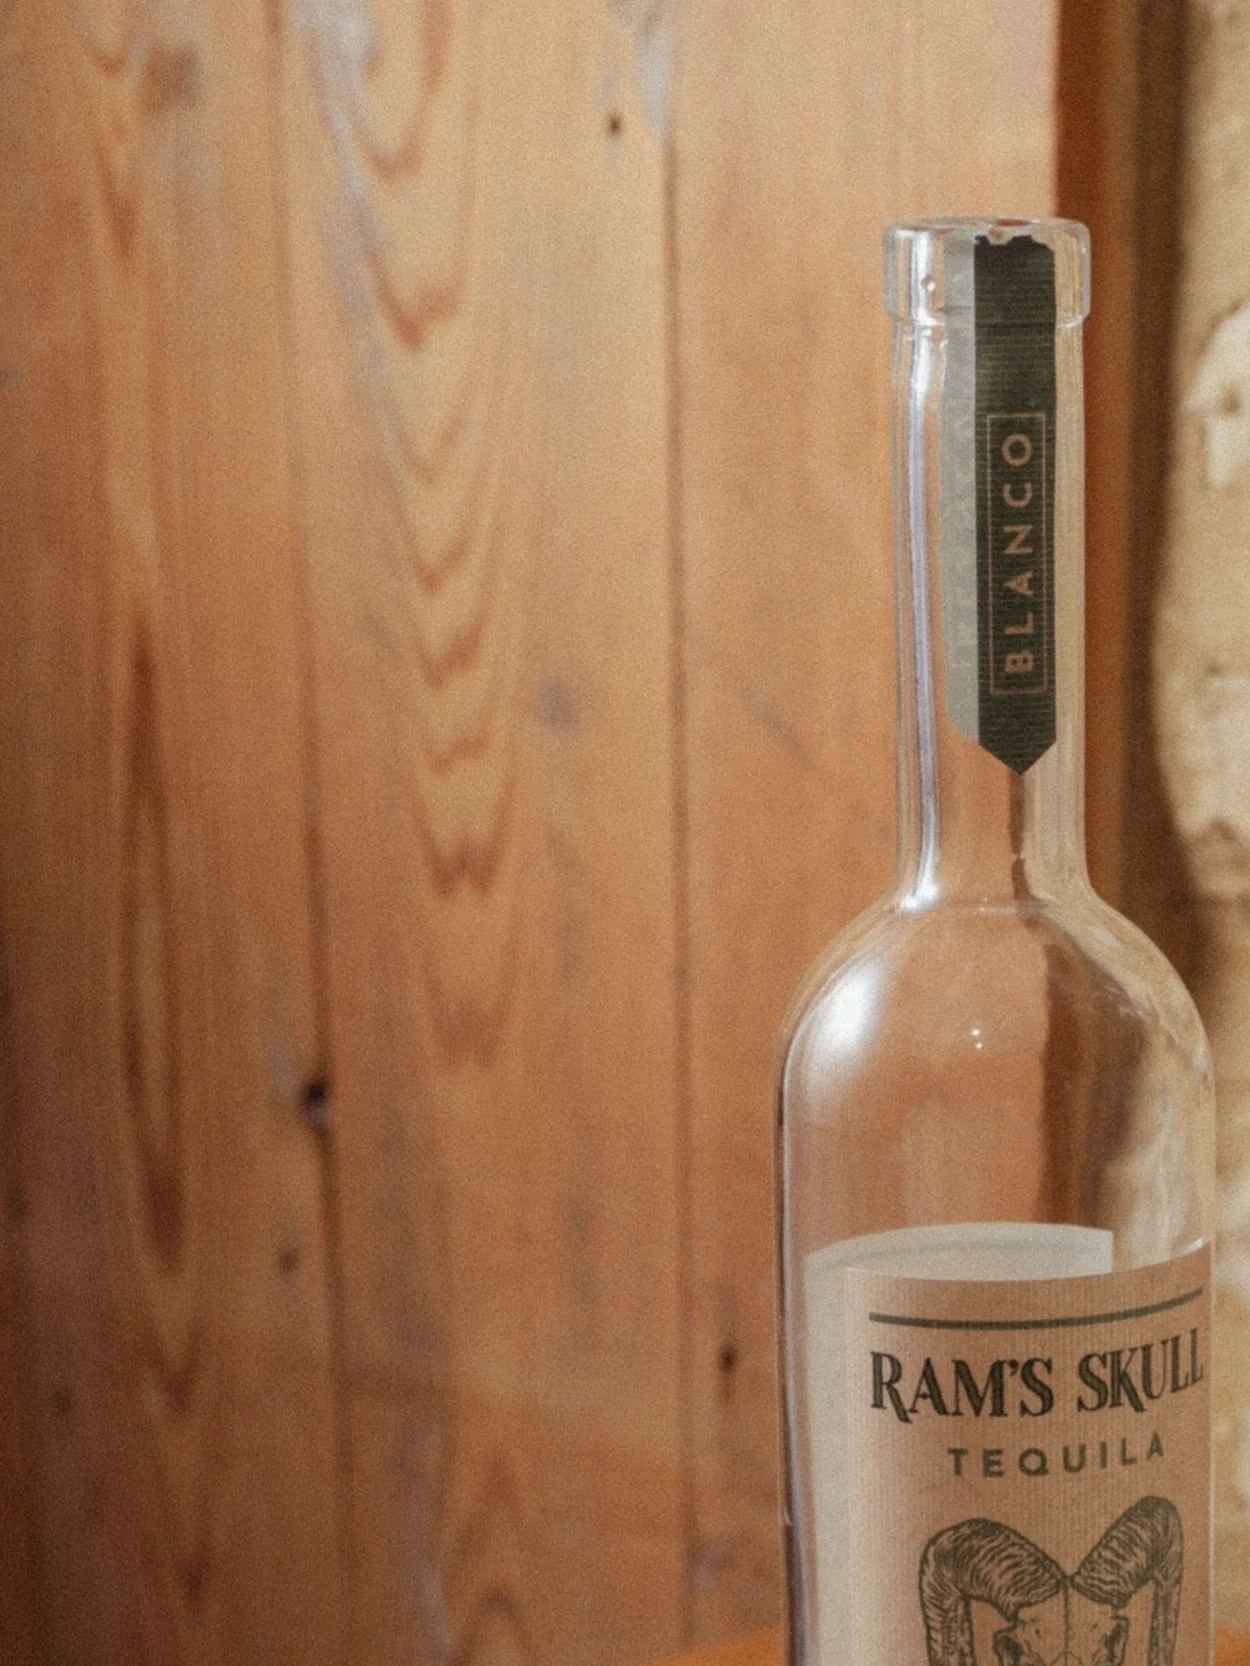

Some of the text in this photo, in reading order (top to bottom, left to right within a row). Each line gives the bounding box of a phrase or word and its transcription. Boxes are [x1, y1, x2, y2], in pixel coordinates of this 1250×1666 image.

[1001, 432, 1034, 674] BLANCO
[869, 1327, 1205, 1424] RAM'S SKULL
[947, 1432, 1166, 1479] TEQUILA
